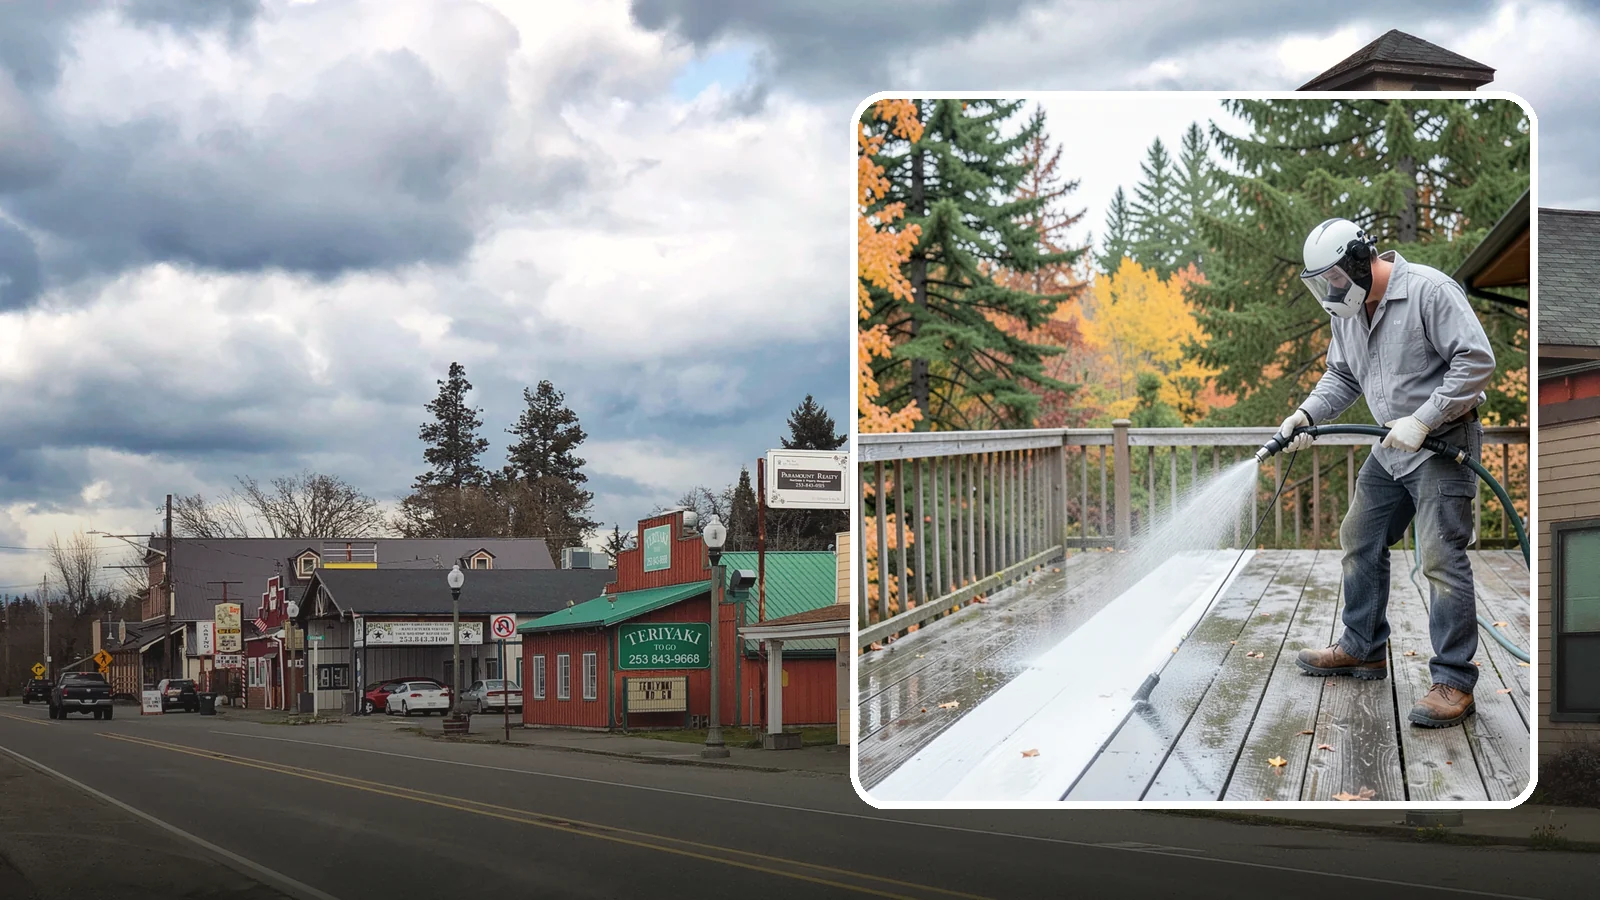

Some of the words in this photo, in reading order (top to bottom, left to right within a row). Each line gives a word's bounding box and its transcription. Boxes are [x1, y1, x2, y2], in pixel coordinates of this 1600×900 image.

[625, 627, 702, 646] TERIYAKI
[629, 654, 649, 664] 253
[651, 653, 700, 664] 843-9668
[639, 681, 673, 691] TERIYAKI
